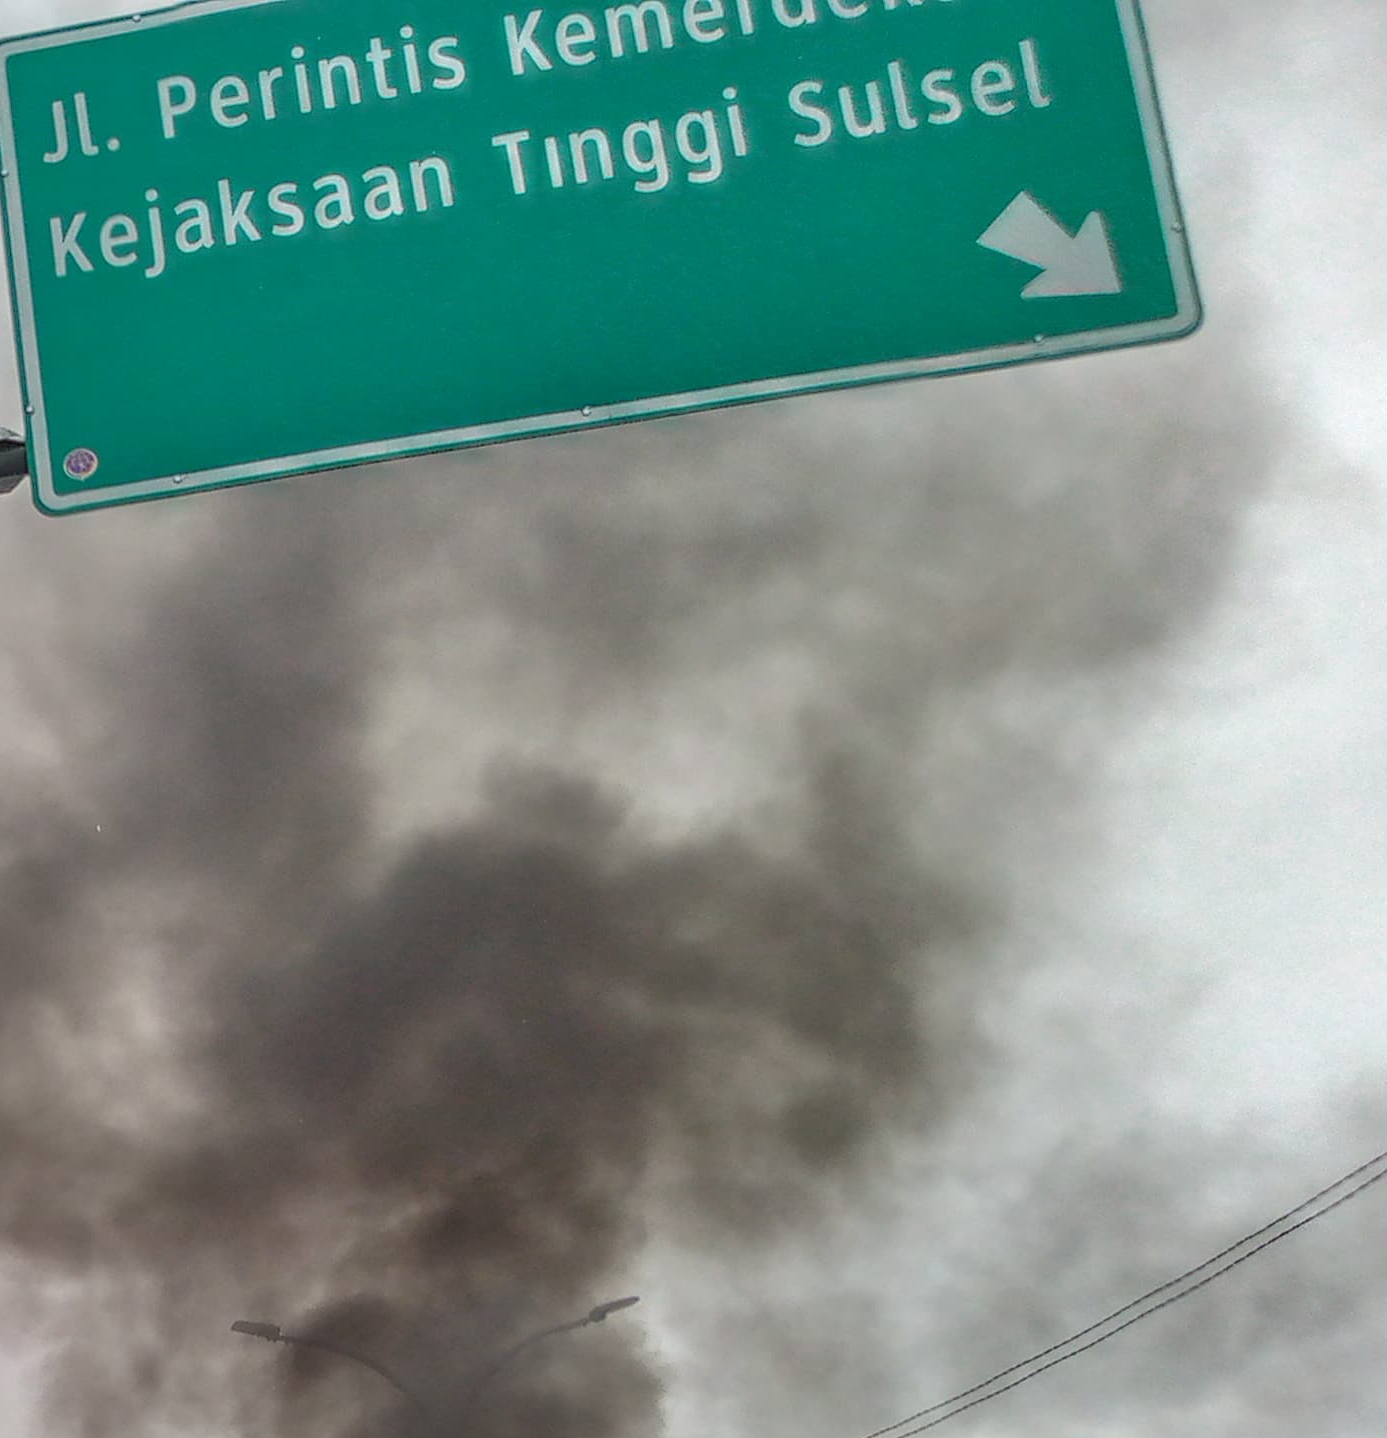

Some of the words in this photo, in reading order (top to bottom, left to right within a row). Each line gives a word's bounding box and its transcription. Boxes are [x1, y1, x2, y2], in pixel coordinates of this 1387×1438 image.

[44, 93, 121, 162] Jl.
[159, 26, 466, 138] Perintis
[504, 0, 955, 74] Kemer
[51, 158, 454, 276] Kejaksaan
[492, 88, 748, 193] Tinggi
[789, 40, 1050, 145] Sulsel
